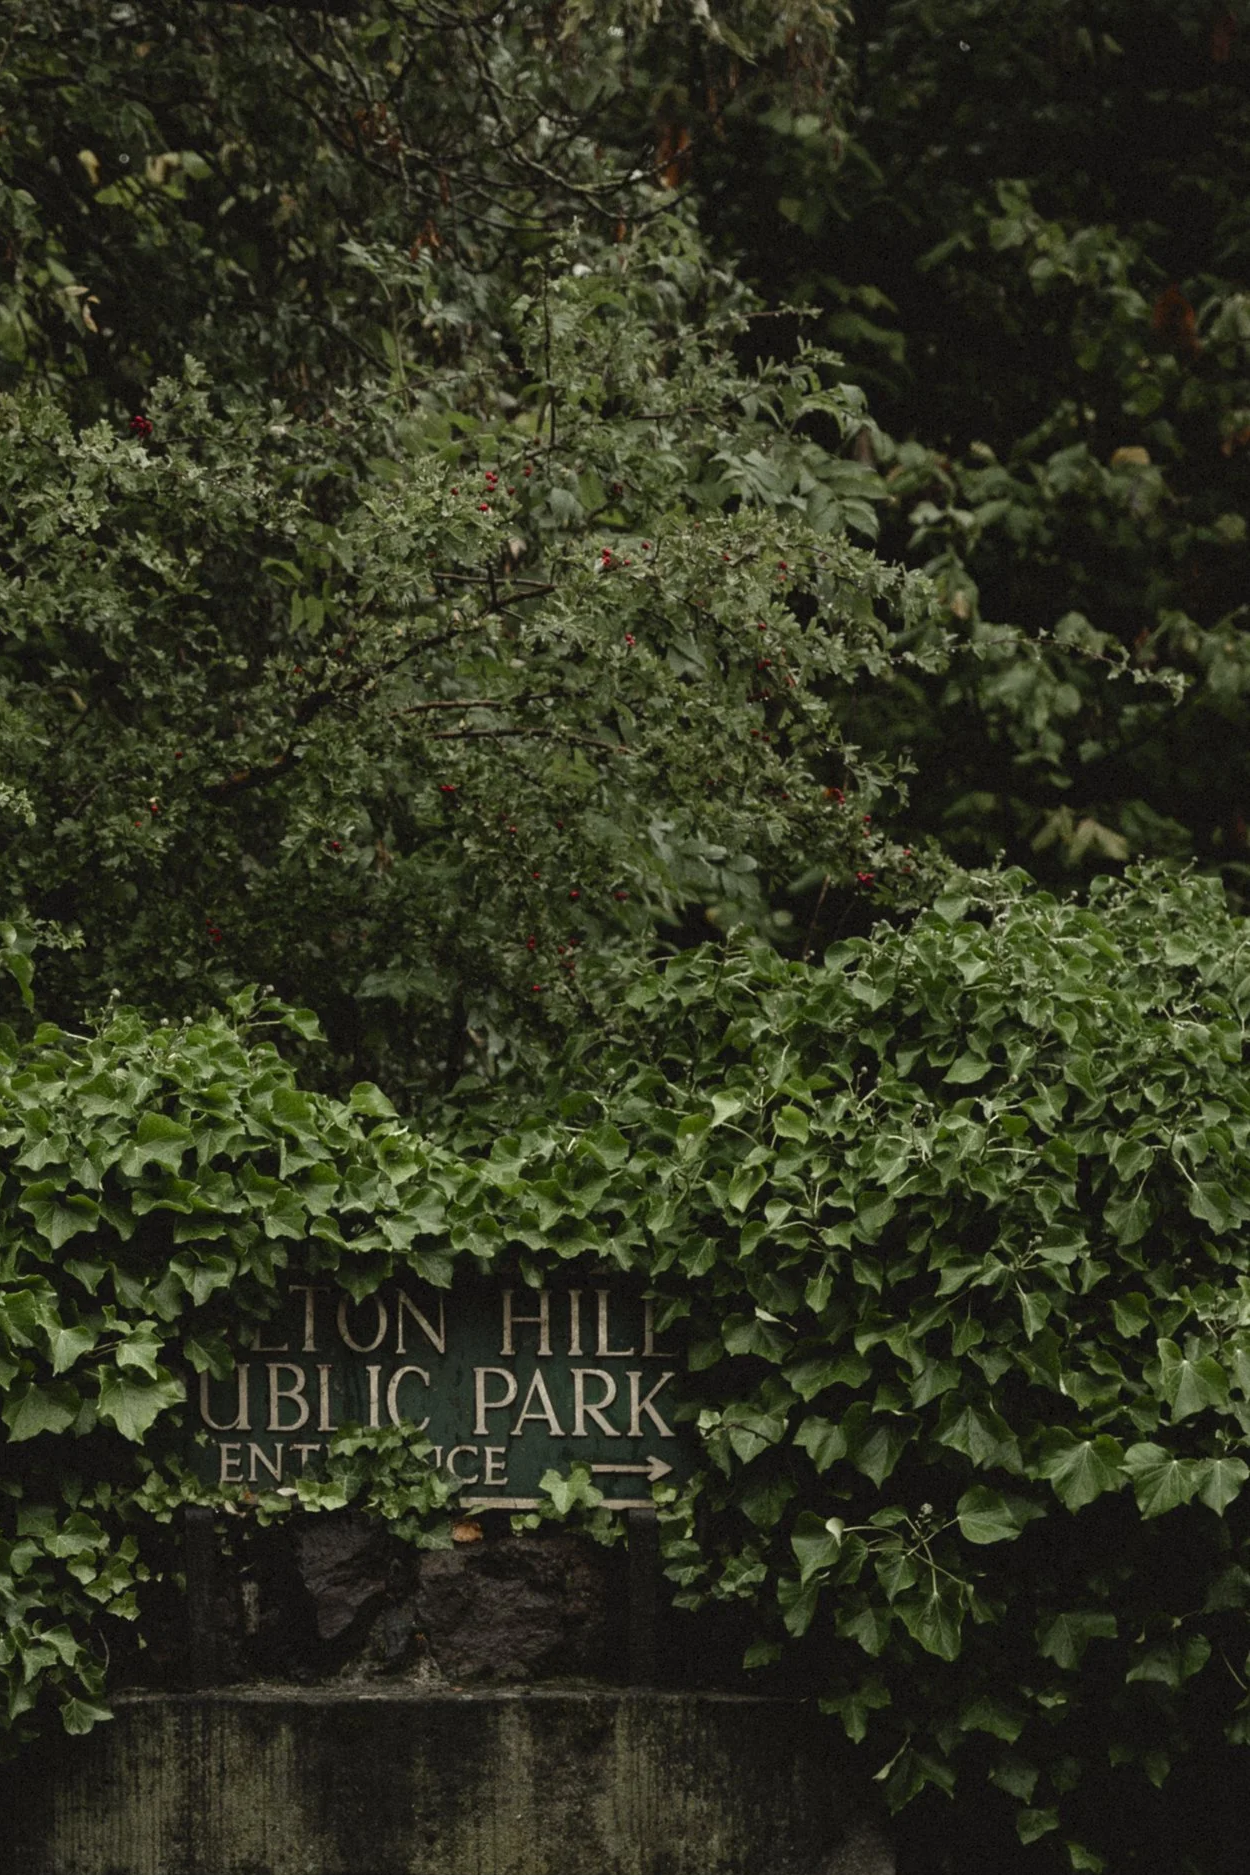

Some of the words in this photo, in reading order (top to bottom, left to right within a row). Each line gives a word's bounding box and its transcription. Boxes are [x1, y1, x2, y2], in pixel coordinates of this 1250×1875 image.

[500, 1289, 679, 1357] HILL
[199, 1363, 431, 1432] UBLIC
[472, 1367, 676, 1437] PARK
[218, 1443, 509, 1486] ENTCE
